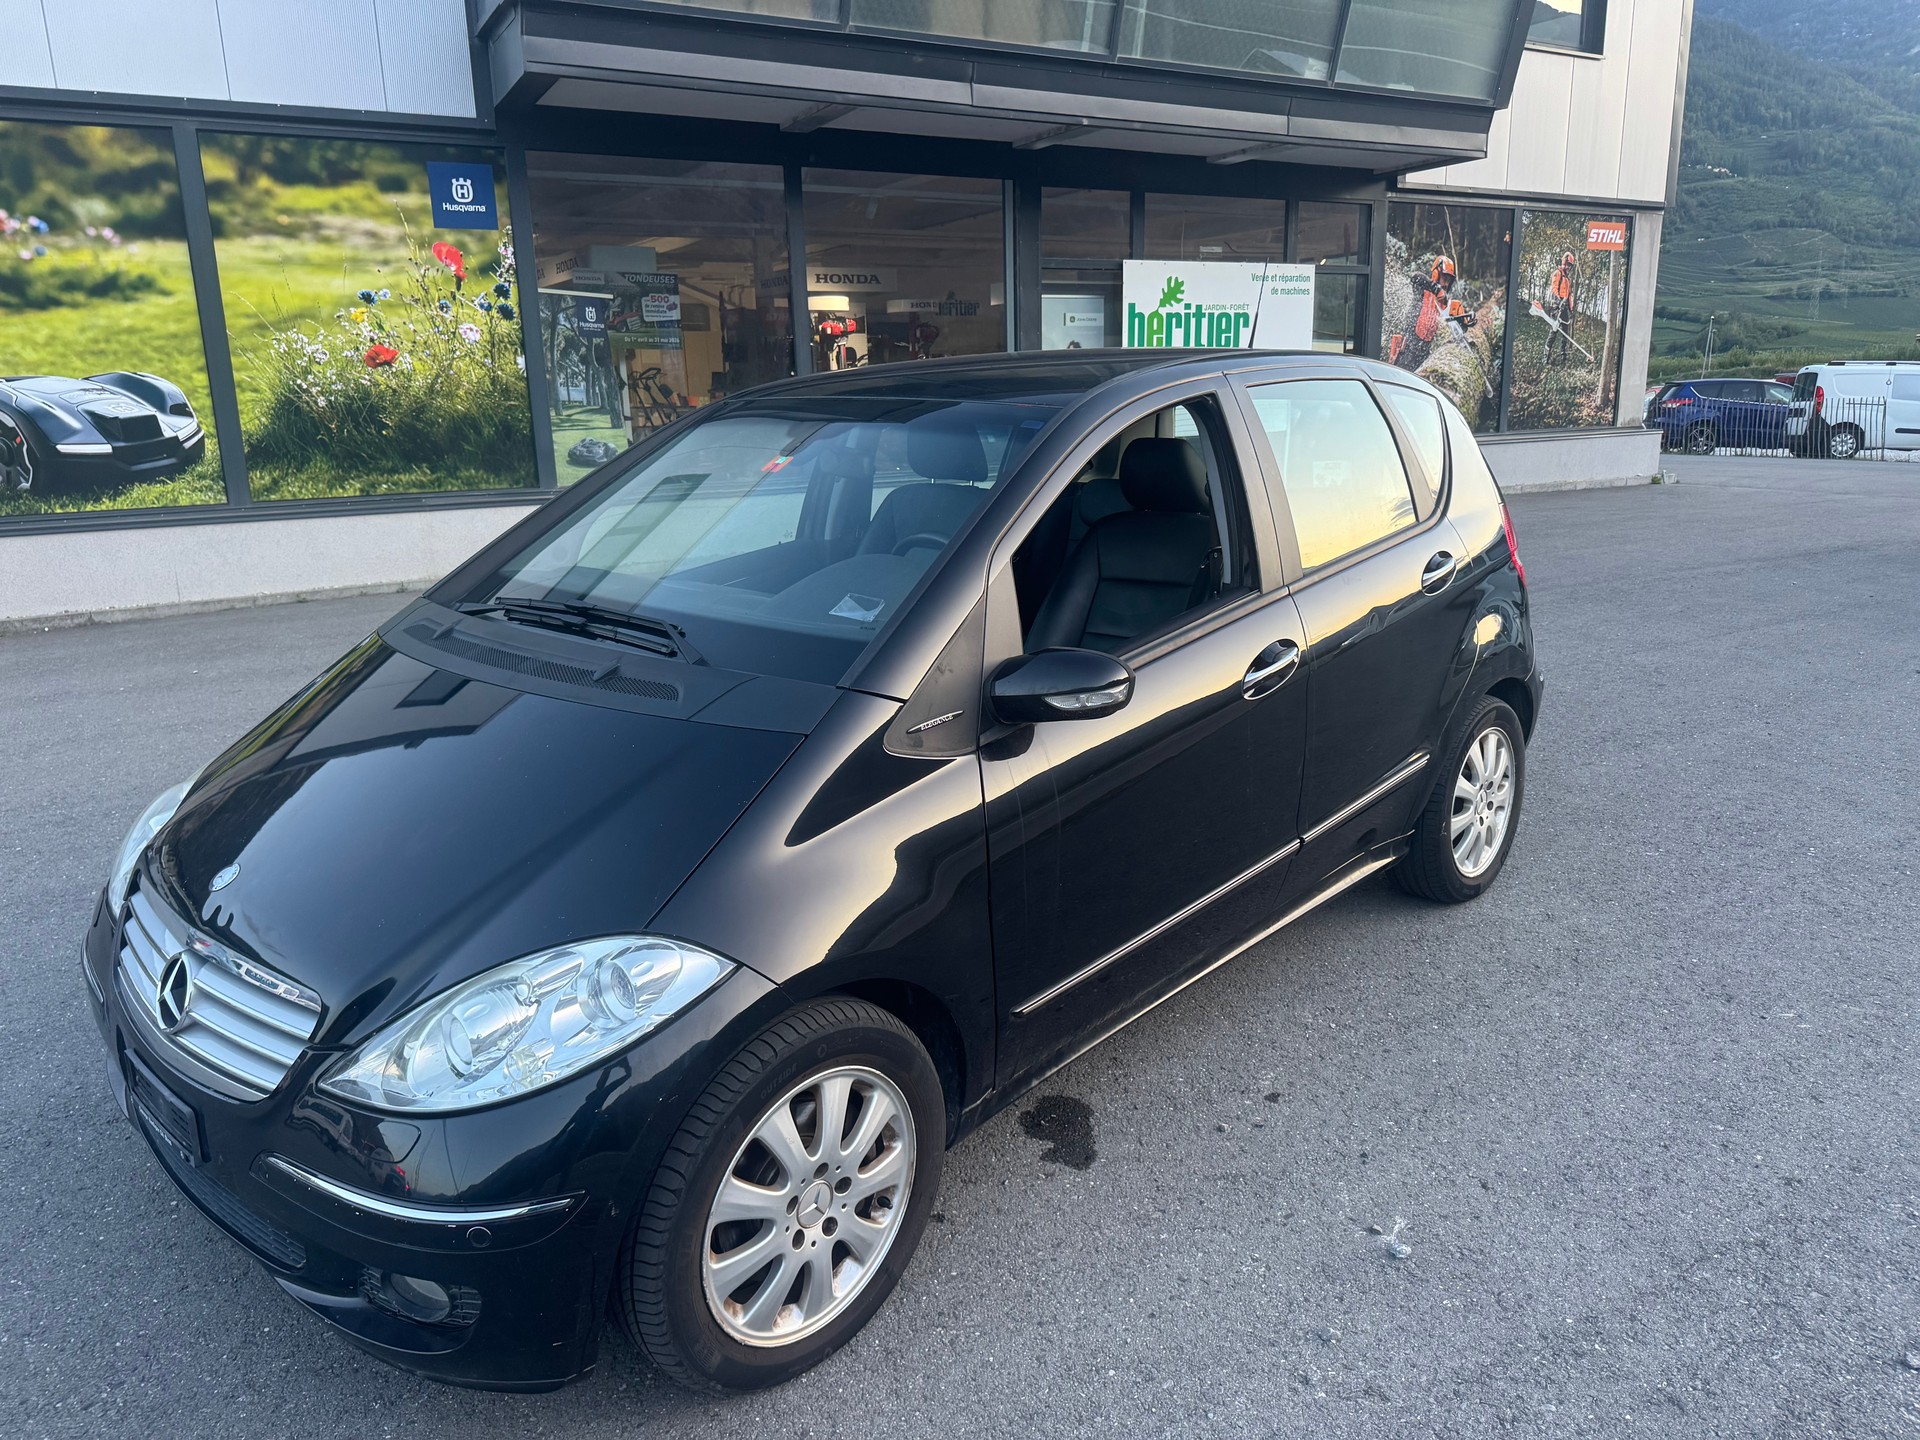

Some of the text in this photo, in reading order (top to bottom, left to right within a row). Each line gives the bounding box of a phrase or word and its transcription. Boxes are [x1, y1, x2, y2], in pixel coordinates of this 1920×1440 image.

[442, 202, 486, 212] Husqvarna
[1588, 228, 1624, 243] STIHL
[555, 257, 579, 274] HONDA
[624, 274, 675, 284] TONDEUSES
[814, 273, 882, 285] HONDA
[1251, 273, 1311, 284] Vene et réparation
[1270, 286, 1310, 296] de machines
[650, 295, 669, 303] 500
[579, 321, 605, 329] Husqvarna
[920, 714, 954, 730] ELEGANCE
